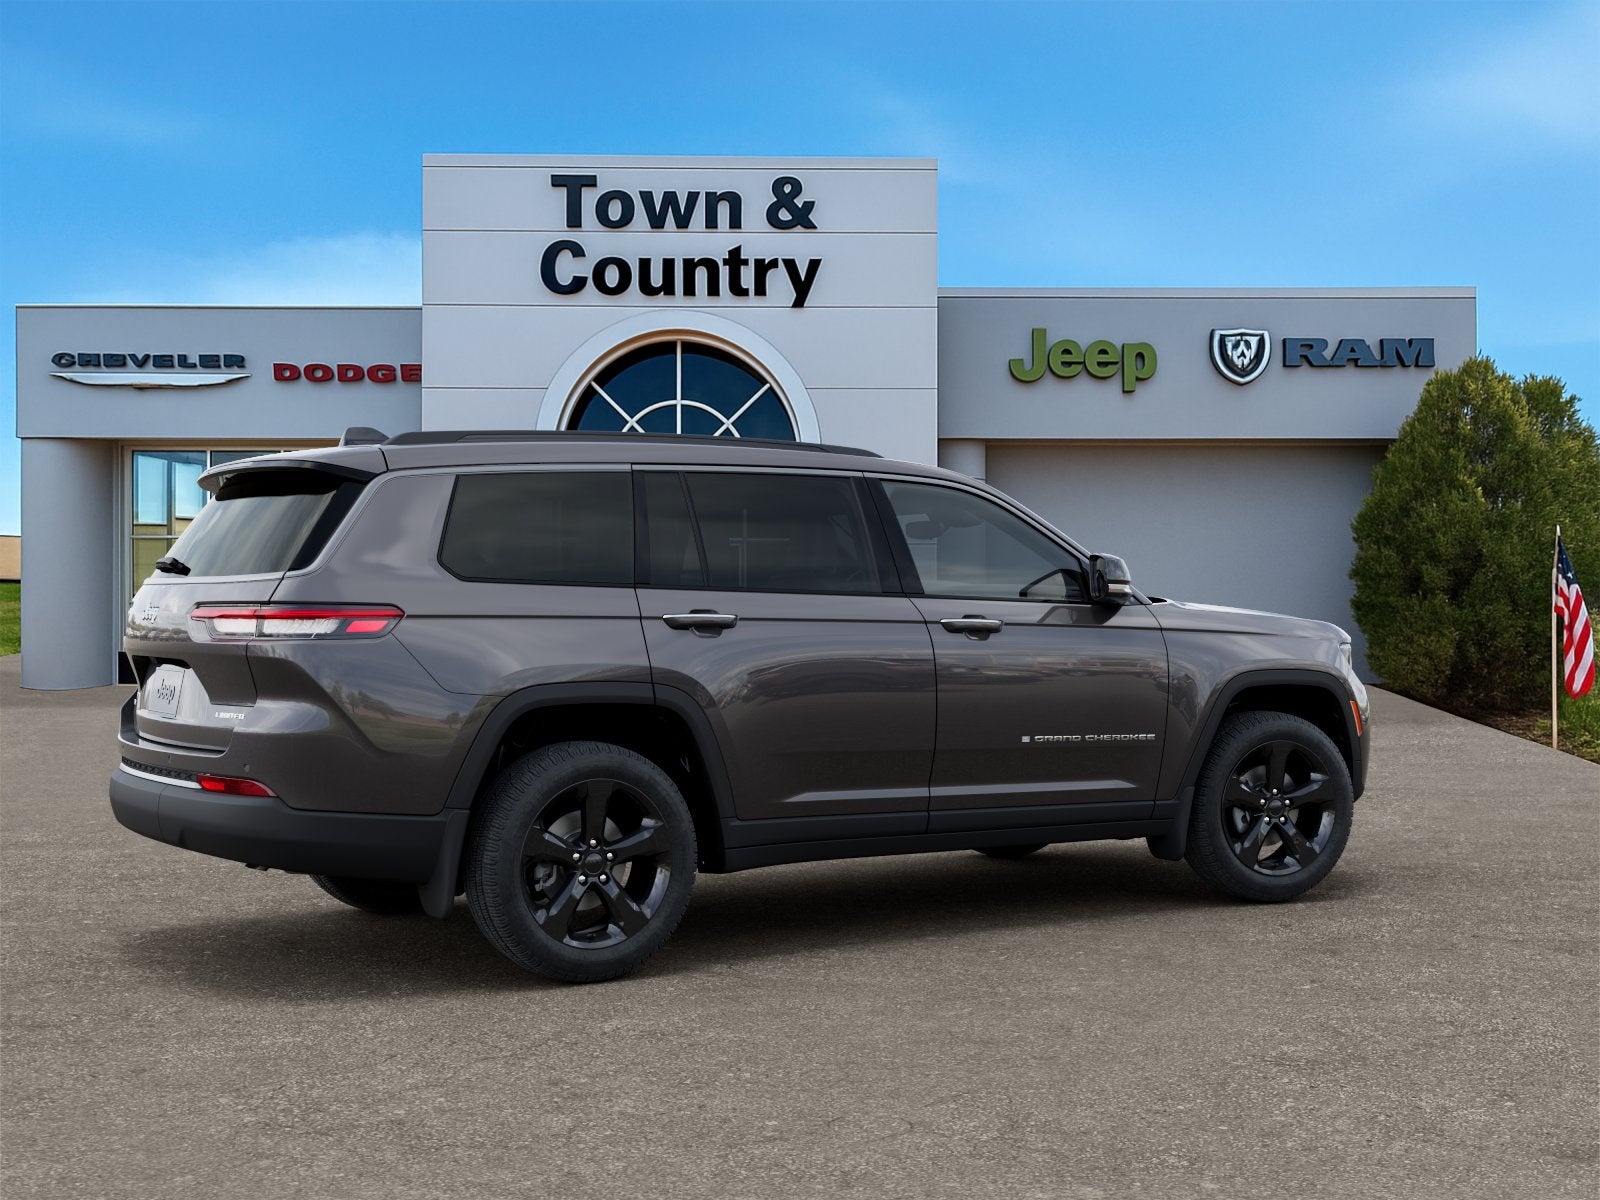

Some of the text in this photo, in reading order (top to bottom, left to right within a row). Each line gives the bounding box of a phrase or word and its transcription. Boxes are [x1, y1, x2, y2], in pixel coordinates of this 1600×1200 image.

[551, 174, 818, 230] Town &
[540, 239, 822, 308] Country
[273, 363, 422, 383] DODGE
[1009, 327, 1157, 393] Jeep
[1283, 338, 1435, 368] RAM
[1085, 733, 1156, 741] CHEROKEE
